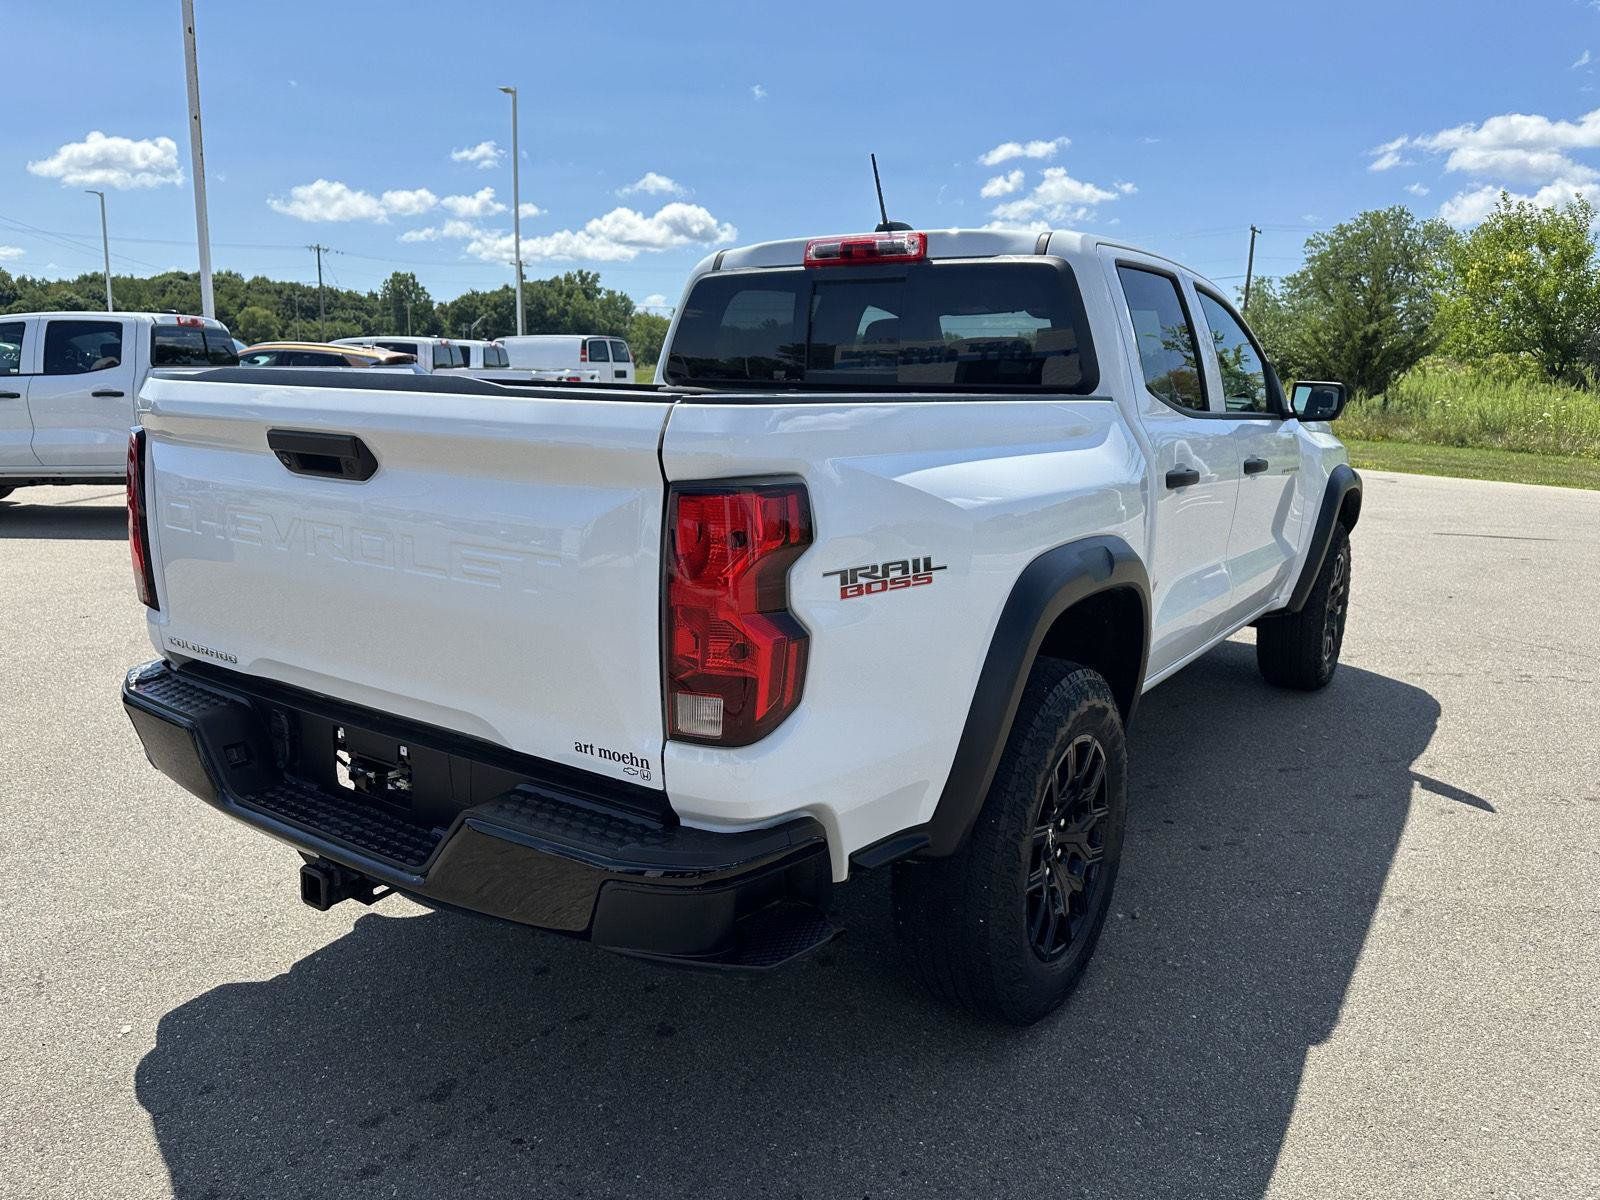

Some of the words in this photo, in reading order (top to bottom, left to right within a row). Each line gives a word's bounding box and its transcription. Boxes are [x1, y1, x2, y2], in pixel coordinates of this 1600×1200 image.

[164, 497, 563, 595] CHEVROLET
[822, 556, 948, 586] TRAIL
[840, 572, 933, 600] BOSS
[168, 636, 238, 664] COLORADO
[574, 741, 595, 756] art
[598, 747, 651, 770] moehn
